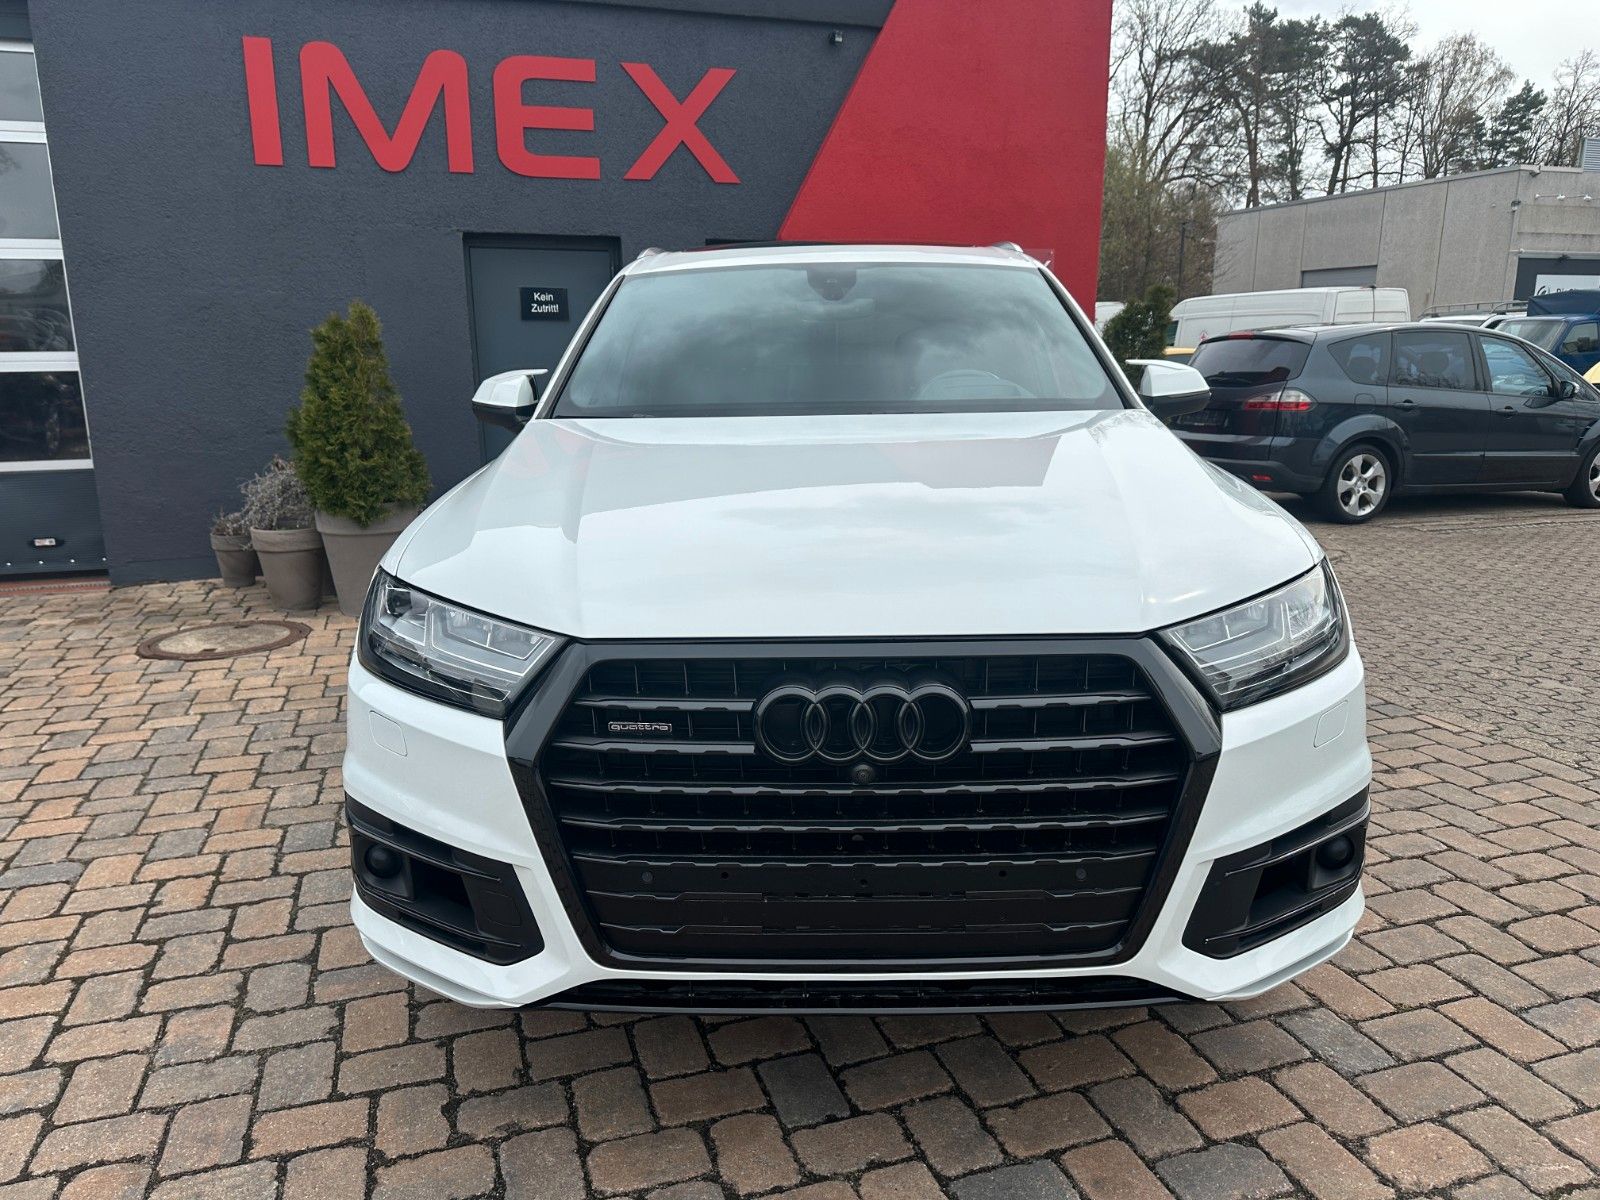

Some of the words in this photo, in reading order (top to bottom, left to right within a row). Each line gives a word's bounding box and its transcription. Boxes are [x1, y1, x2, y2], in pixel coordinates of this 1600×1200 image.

[242, 36, 741, 184] IMEX
[533, 292, 554, 301] Kein
[531, 303, 559, 313] Zutritt!
